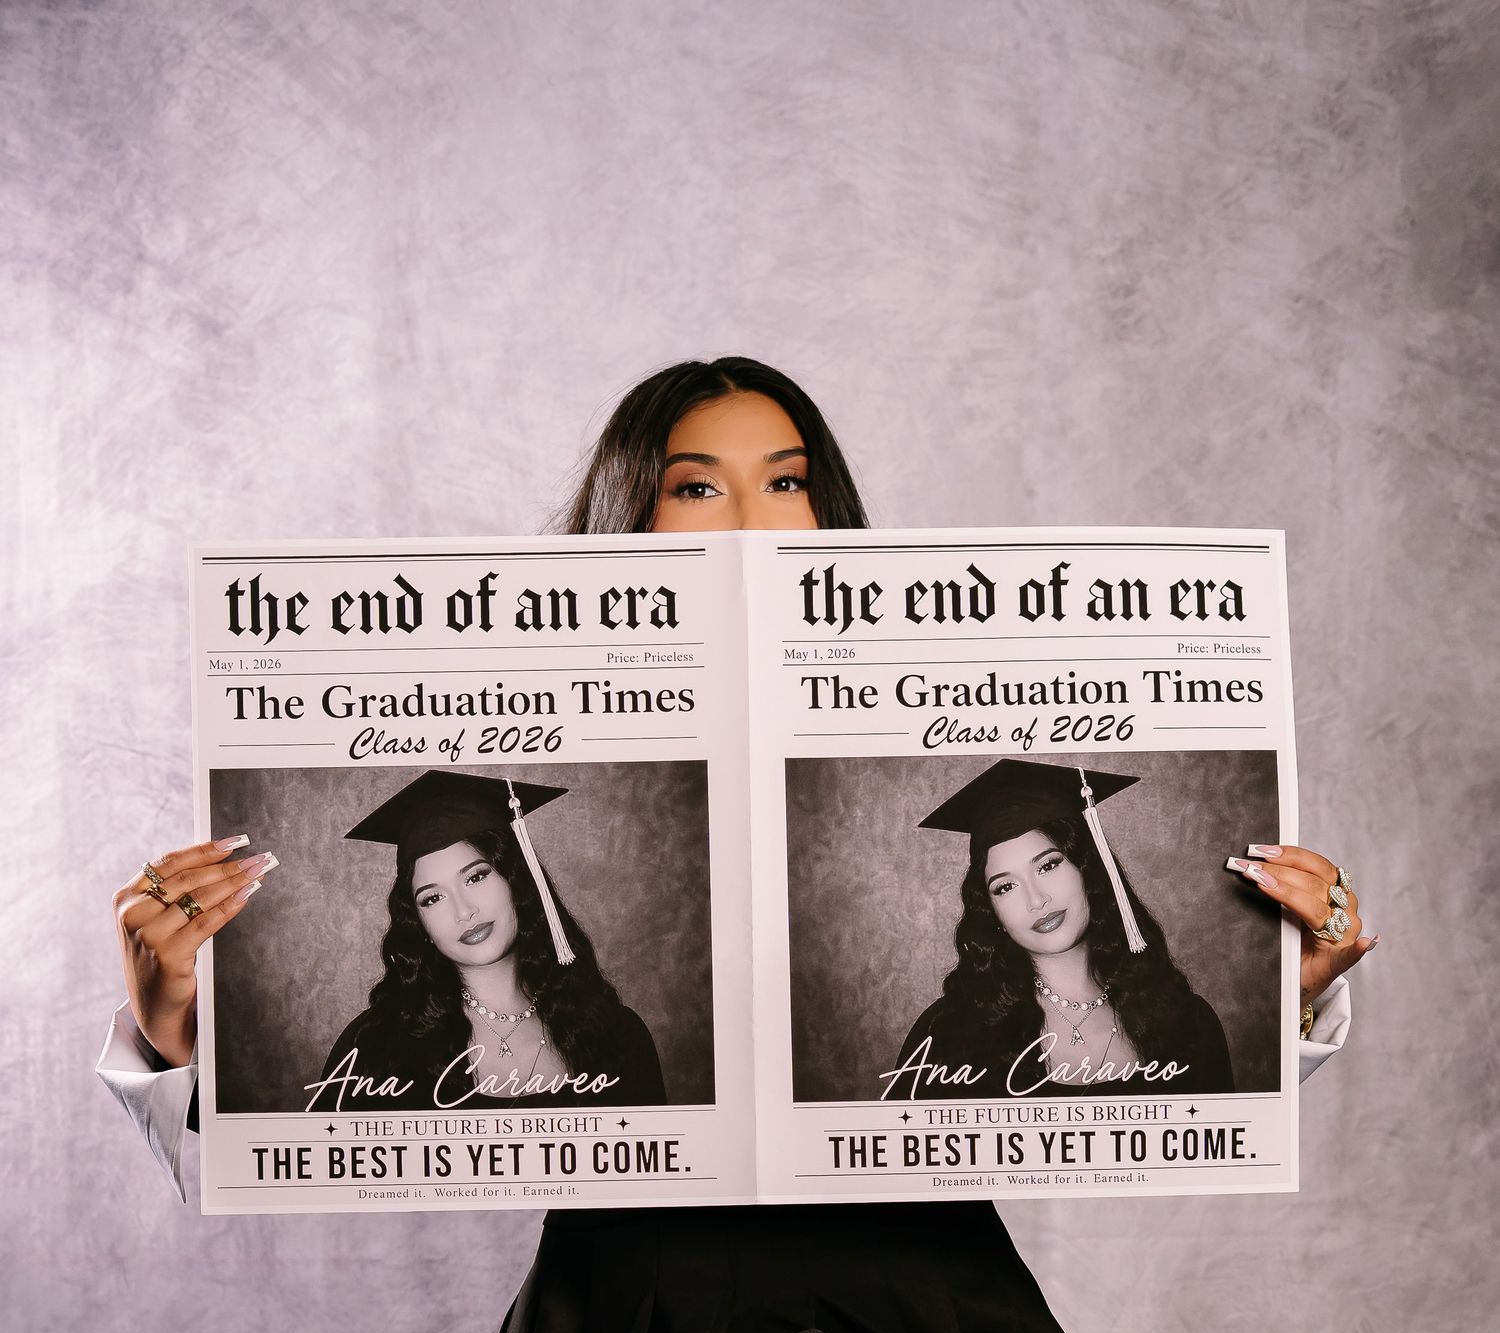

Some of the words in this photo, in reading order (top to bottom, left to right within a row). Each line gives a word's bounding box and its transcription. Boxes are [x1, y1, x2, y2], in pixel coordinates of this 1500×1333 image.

[224, 572, 311, 646] the
[330, 572, 424, 636] end
[445, 571, 500, 634] of
[514, 587, 582, 632] an
[599, 585, 680, 631] era
[798, 562, 884, 636] the
[904, 562, 997, 625] end
[1018, 560, 1072, 623] of
[1086, 577, 1152, 622] an
[1169, 578, 1247, 622] era
[208, 658, 235, 674] May
[238, 658, 250, 671] 1,
[252, 657, 283, 671] 2026
[606, 651, 640, 664] Price:
[643, 650, 695, 664] Priceless
[783, 647, 810, 663] May
[813, 648, 824, 661] 1,
[826, 647, 857, 660] 2026
[1176, 642, 1210, 655] Price:
[1212, 642, 1263, 655] Priceless
[225, 685, 305, 720] The
[321, 682, 558, 719] Graduation
[571, 680, 695, 714] Times
[800, 674, 879, 710] The
[895, 671, 1130, 708] Graduation
[1142, 669, 1264, 703] Times
[348, 726, 429, 761] Class
[438, 728, 466, 763] of
[477, 725, 564, 754] 2026
[922, 715, 1002, 750] Class
[1010, 716, 1038, 752] of
[1049, 714, 1136, 743] 2026
[303, 1047, 414, 1112] Ana
[433, 1045, 620, 1109] Caraveo
[879, 1035, 987, 1100] Ana
[1006, 1032, 1189, 1095] Caraveo
[350, 1120, 394, 1137] THE
[401, 1119, 487, 1136] FUTURE
[495, 1118, 513, 1134] IS
[521, 1116, 603, 1134] BRIGHT
[924, 1108, 968, 1125] THE
[974, 1106, 1060, 1124] FUTURE
[1066, 1106, 1085, 1122] IS
[1093, 1104, 1173, 1121] BRIGHT
[251, 1147, 313, 1181] THE
[328, 1145, 408, 1179] BEST
[423, 1144, 452, 1178] IS
[466, 1143, 524, 1177] YET
[538, 1142, 577, 1175] TO
[592, 1140, 691, 1175] COME.
[828, 1135, 888, 1169] THE
[903, 1133, 981, 1167] BEST
[996, 1132, 1025, 1165] IS
[1039, 1130, 1096, 1164] YET
[1109, 1129, 1147, 1163] TO
[1162, 1127, 1257, 1162] COME.
[357, 1187, 410, 1200] Dreamed
[413, 1187, 427, 1199] it.
[433, 1186, 479, 1198] Worked
[482, 1185, 501, 1198] for
[503, 1185, 517, 1198] it.
[522, 1184, 563, 1197] Earned
[567, 1184, 581, 1196] it.
[931, 1175, 984, 1188] Dreamed
[986, 1174, 1000, 1187] it.
[1006, 1173, 1051, 1186] Worked
[1054, 1173, 1072, 1185] for
[1074, 1173, 1088, 1185] it.
[1093, 1171, 1134, 1184] Earned
[1136, 1171, 1150, 1183] it.
